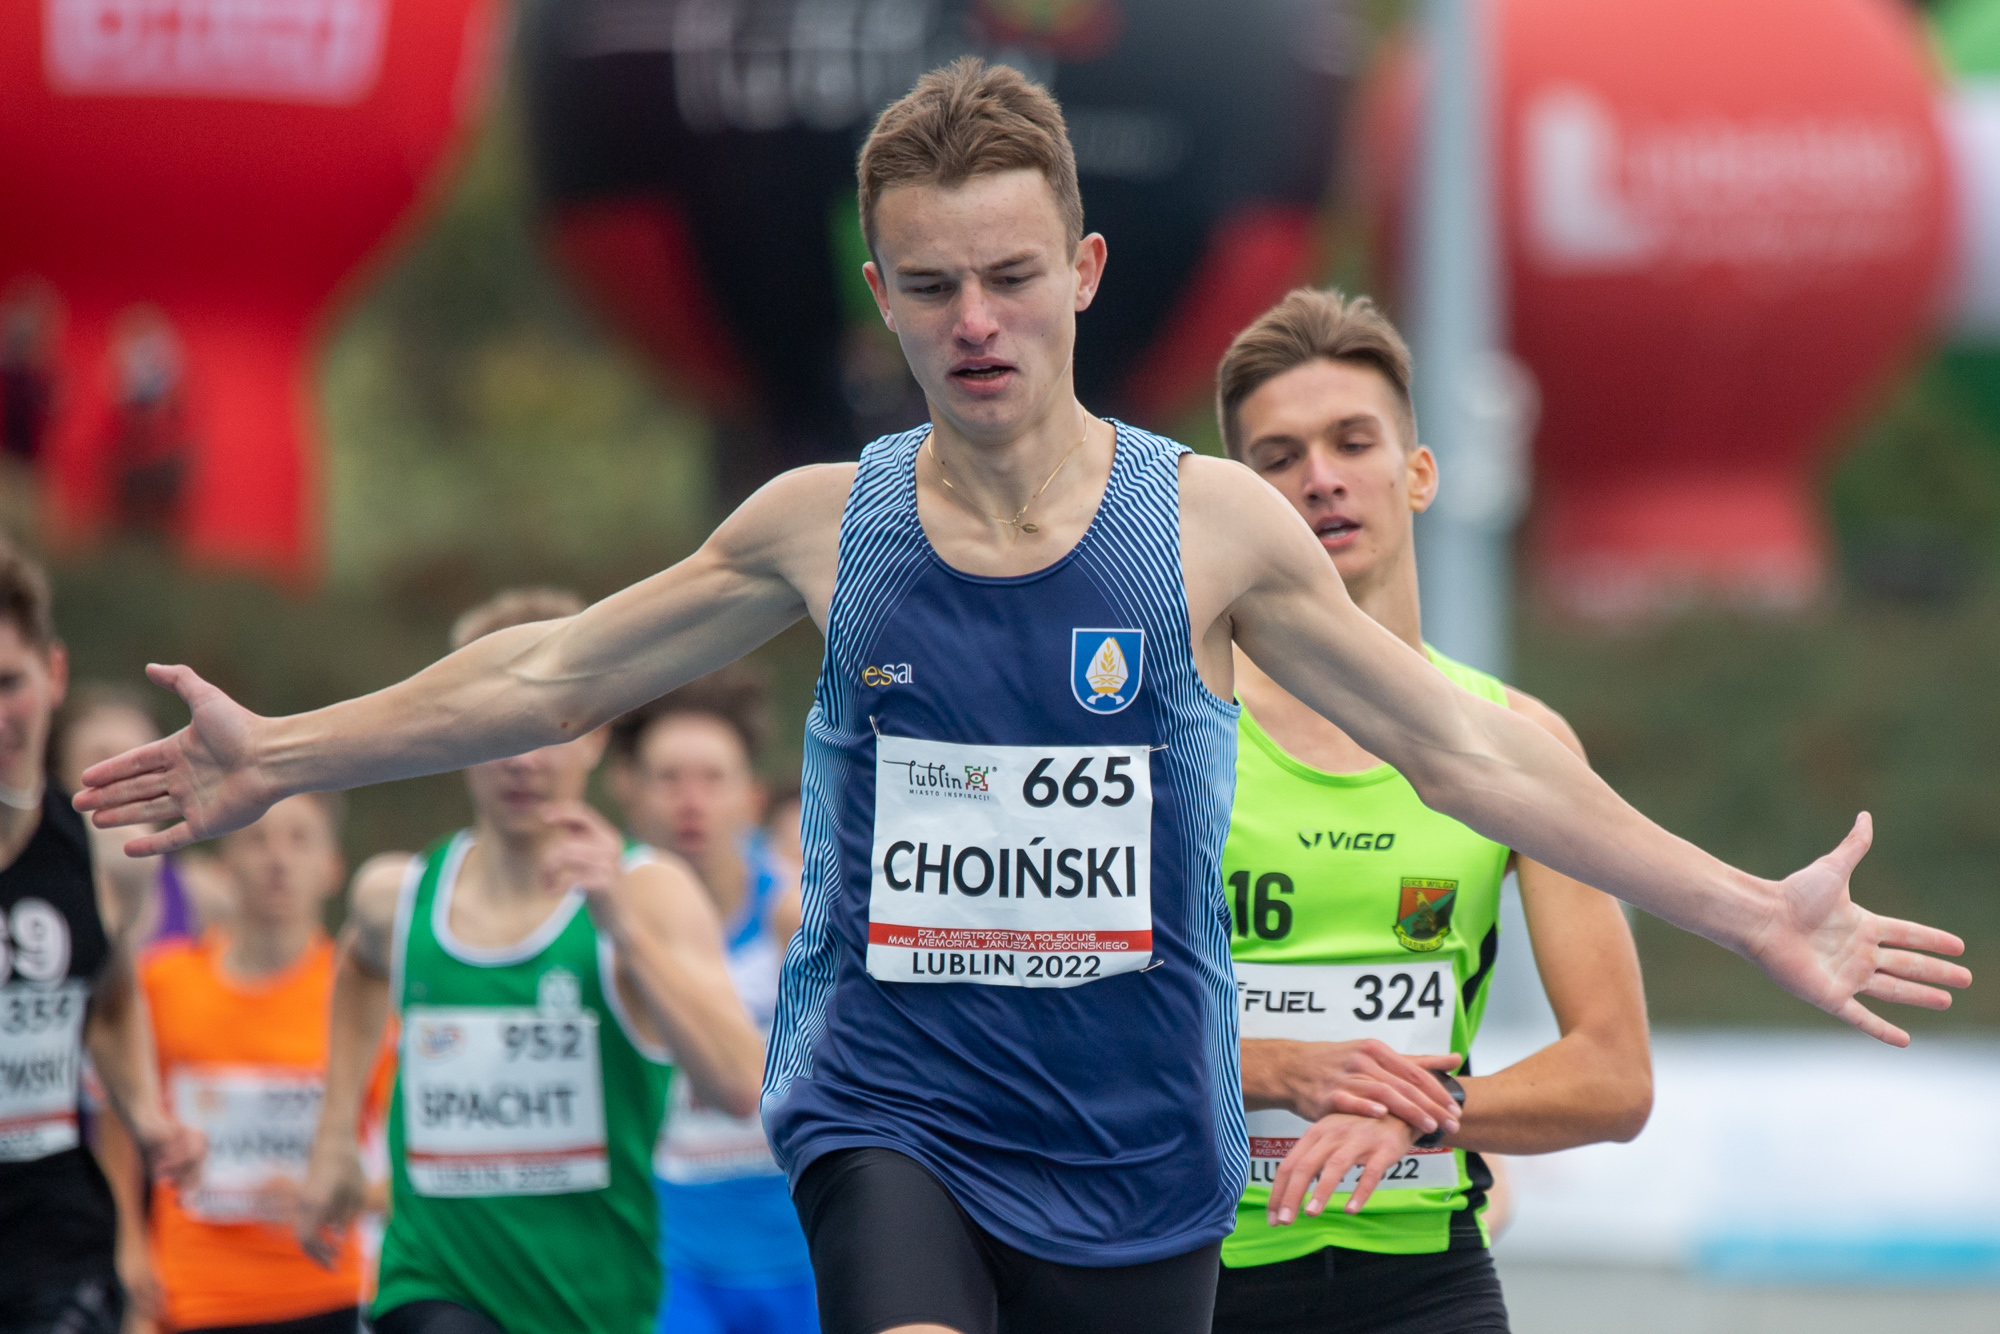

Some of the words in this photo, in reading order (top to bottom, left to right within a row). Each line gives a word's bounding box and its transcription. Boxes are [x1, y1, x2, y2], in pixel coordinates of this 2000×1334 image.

[882, 760, 962, 790] lublin
[909, 789, 940, 797] MIASTO
[944, 791, 990, 801] INSPIRACJI
[1023, 756, 1135, 808] 665
[883, 836, 1137, 899] CHOIŃSKI
[1228, 869, 1294, 941] 16
[0, 896, 72, 983] 9
[887, 935, 915, 946] MAŁY
[918, 938, 980, 948] MEMORIAŁ
[983, 940, 1037, 950] JANUSZA
[917, 929, 947, 939] PZLA
[950, 930, 1032, 941] MISTRZOSTWA
[1034, 933, 1074, 942] POLSKI
[1076, 933, 1097, 942] U16
[912, 952, 1014, 976] LUBLIN
[1026, 955, 1101, 979] 2022
[1353, 971, 1445, 1022] 324
[503, 1023, 583, 1062] 952
[421, 1084, 575, 1129] SPACHT
